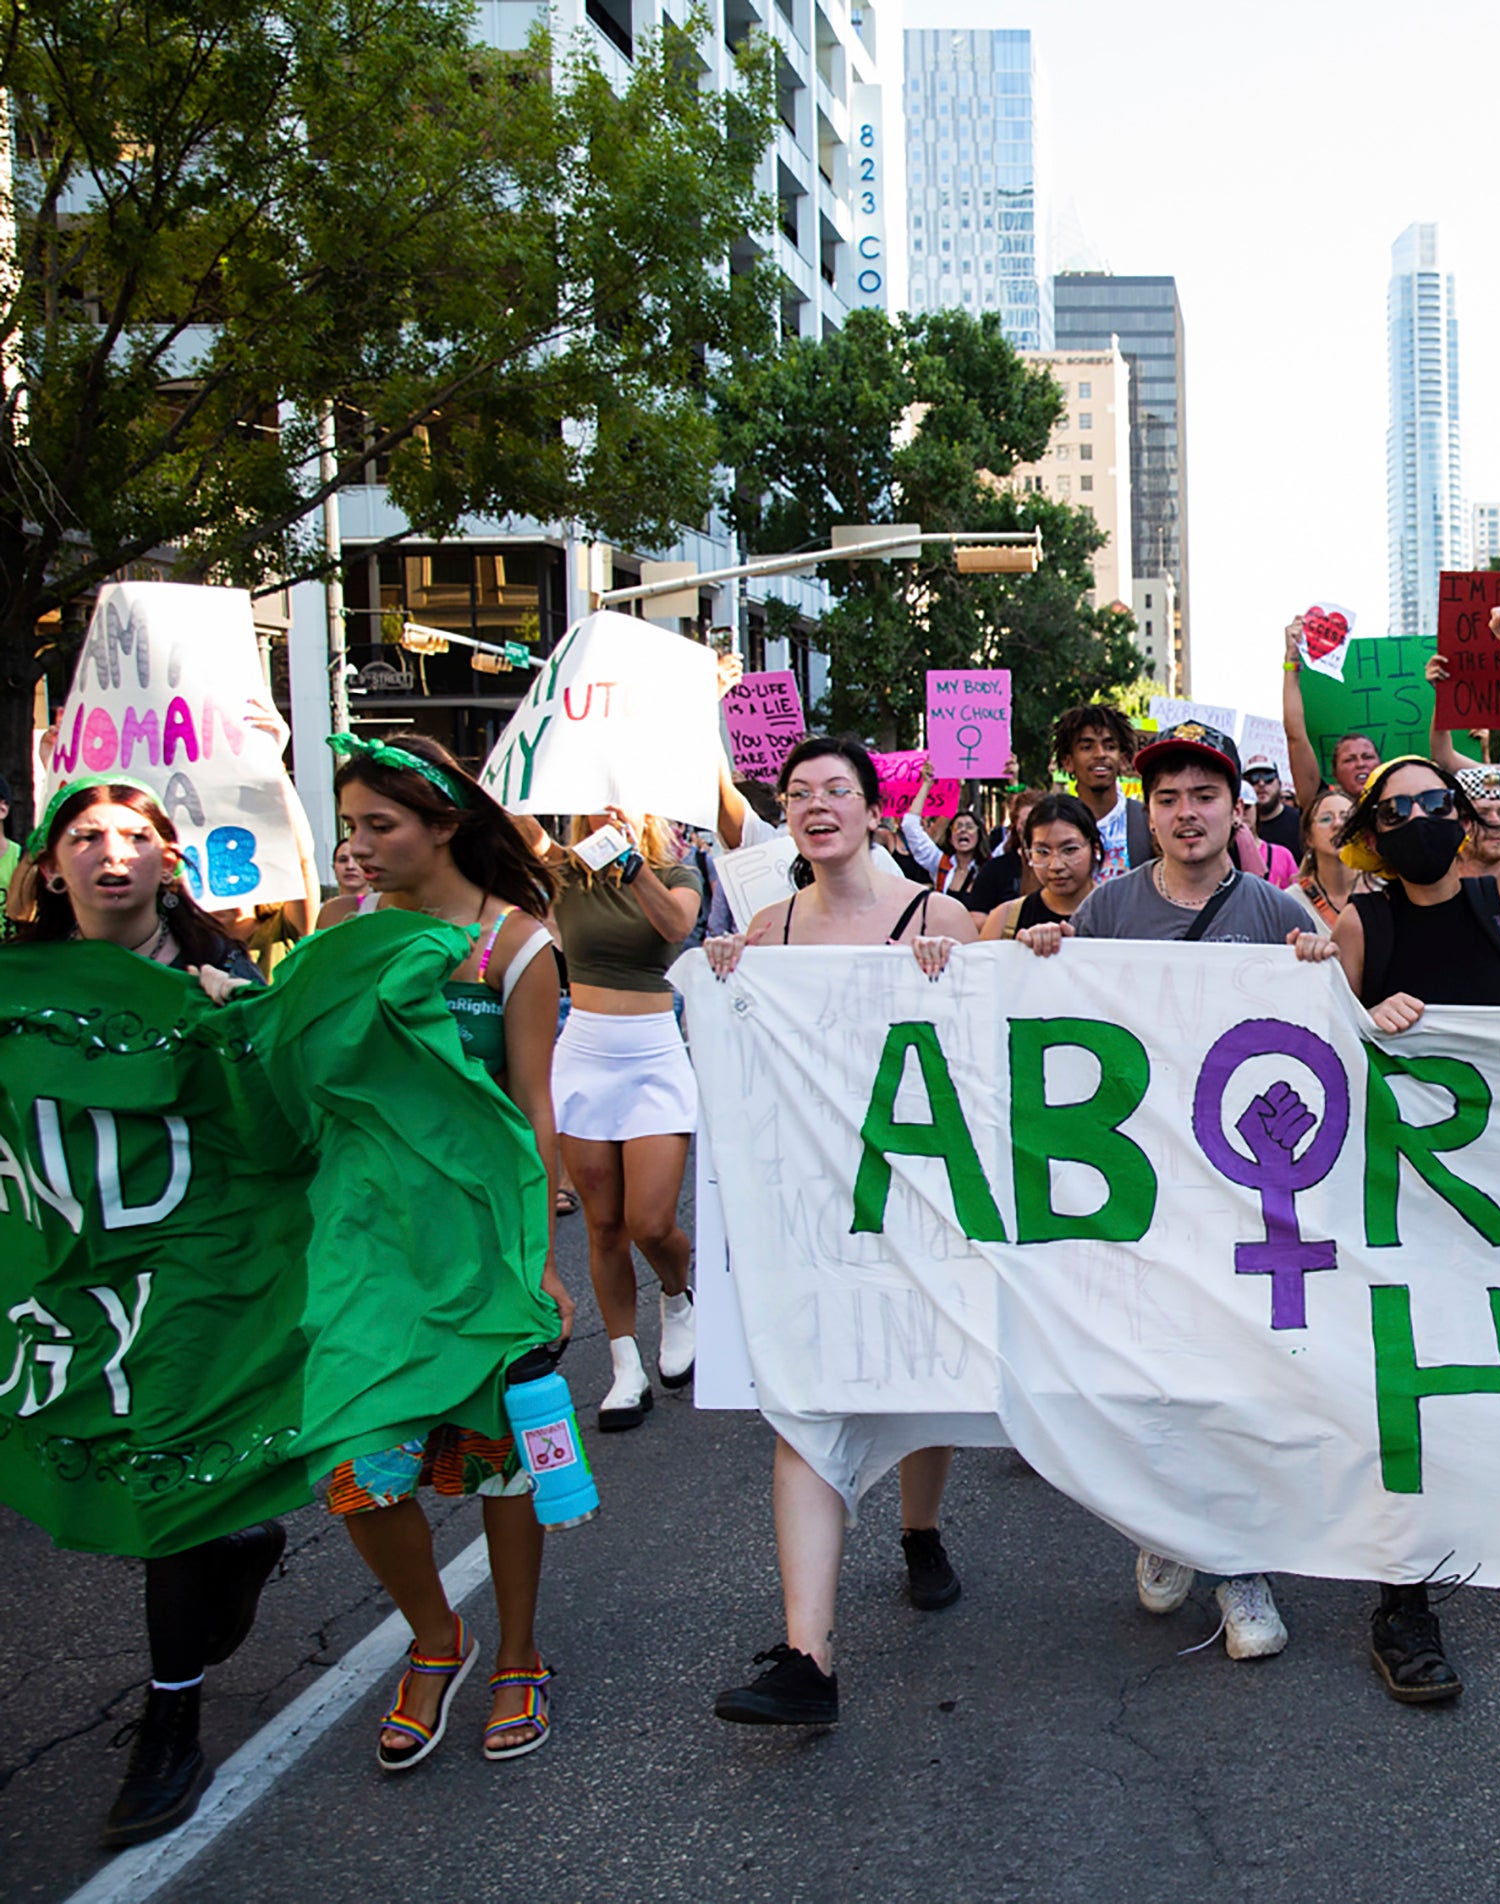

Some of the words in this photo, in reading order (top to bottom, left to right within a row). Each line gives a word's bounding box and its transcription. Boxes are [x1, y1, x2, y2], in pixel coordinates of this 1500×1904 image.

[859, 124, 876, 214] 823
[1443, 576, 1485, 602] I'M
[1456, 612, 1480, 643] OF
[79, 600, 150, 692] AM
[1454, 651, 1485, 672] THE
[936, 680, 958, 694] MY
[729, 705, 743, 715] IS
[931, 705, 956, 719] MY
[961, 704, 1007, 721] CHOICE
[1348, 685, 1422, 730] IS
[53, 696, 243, 774] WOMAN
[731, 731, 761, 750] YOU
